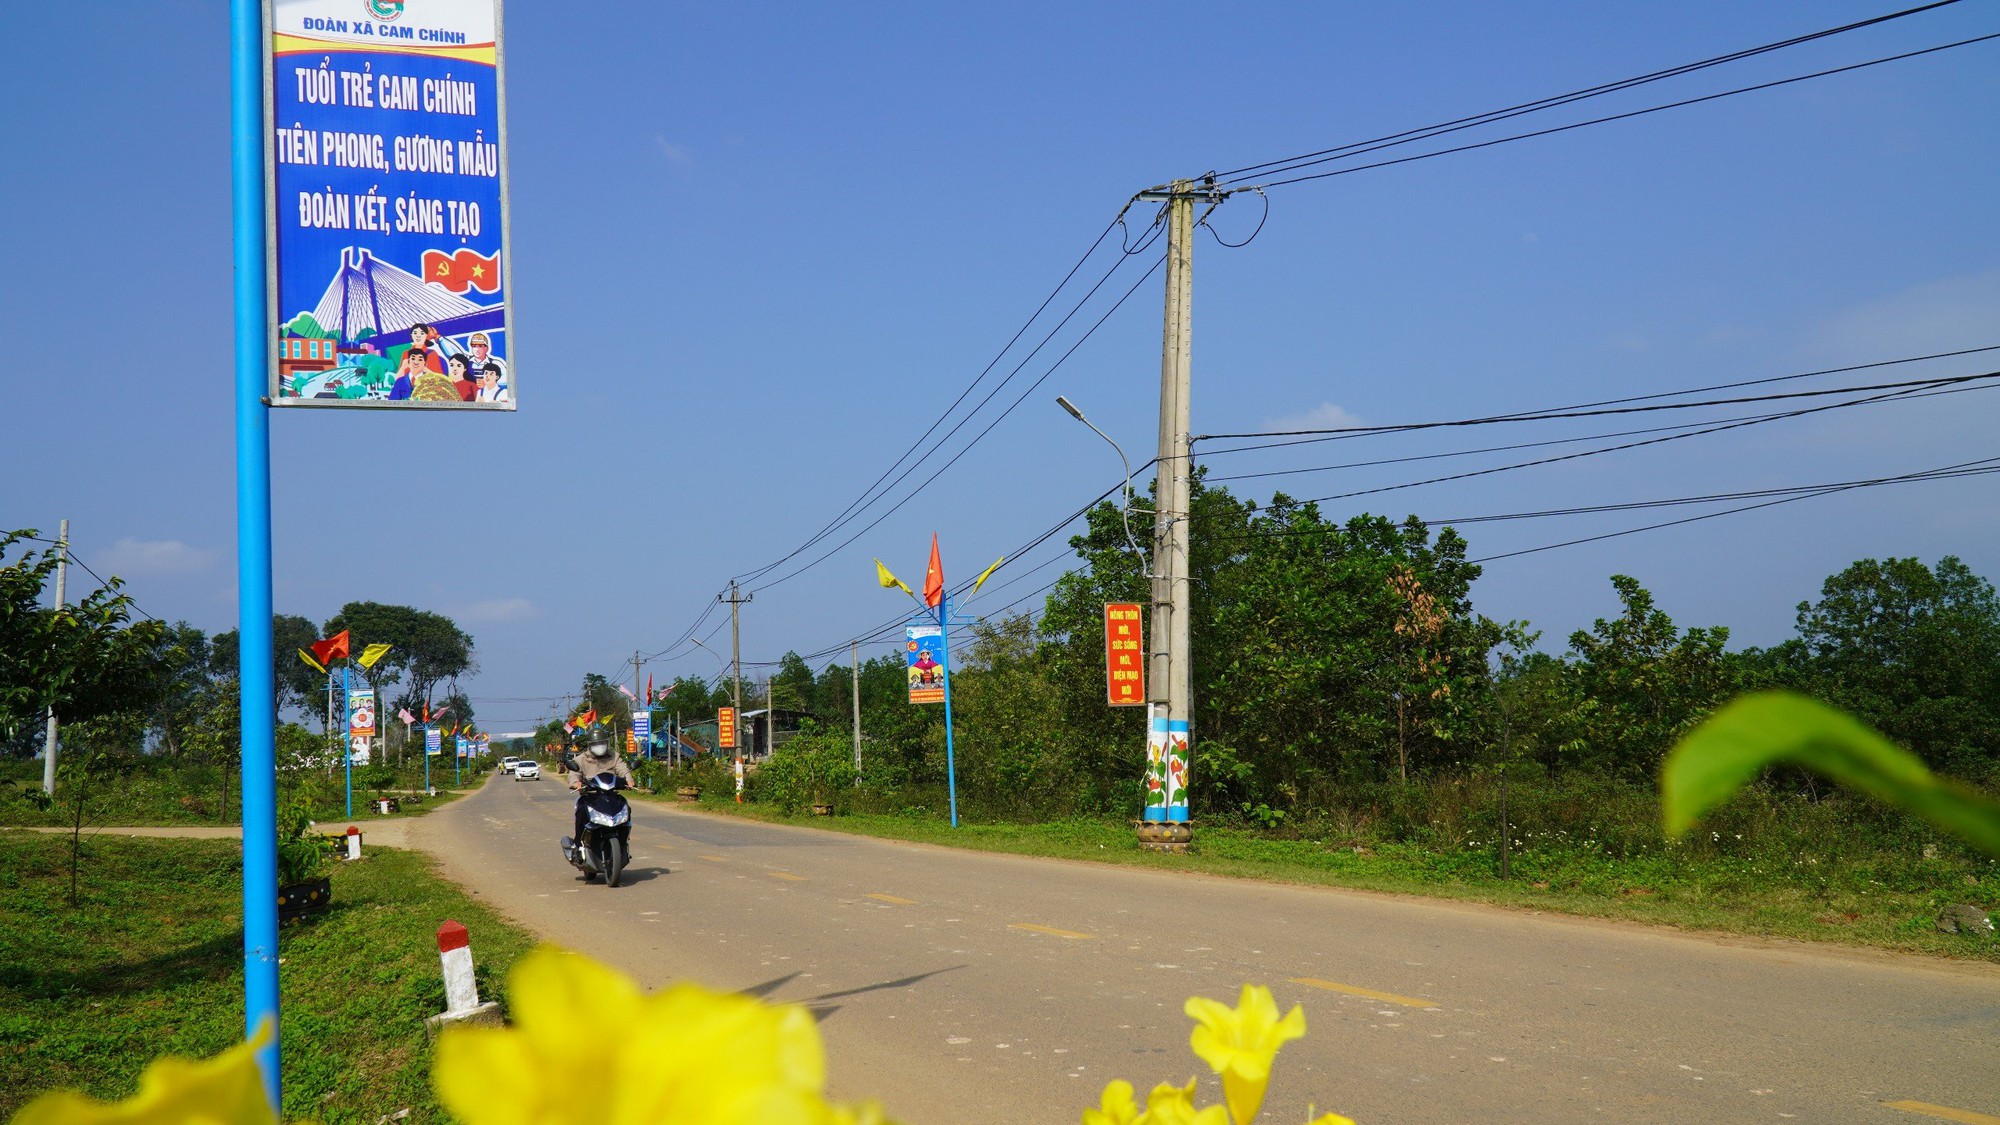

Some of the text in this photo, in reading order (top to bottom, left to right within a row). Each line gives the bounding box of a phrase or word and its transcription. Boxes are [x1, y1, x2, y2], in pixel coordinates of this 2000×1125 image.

[303, 17, 466, 44] ĐOÀN XÃ CAM CHÍNH
[295, 56, 476, 116] TUỔI TRẺ CAM CHÍNH
[276, 122, 497, 177] TIÊN PHONG, GƯƠNG MẪU
[299, 185, 480, 243] ĐOÀN KẾT, SÁNG TẠO
